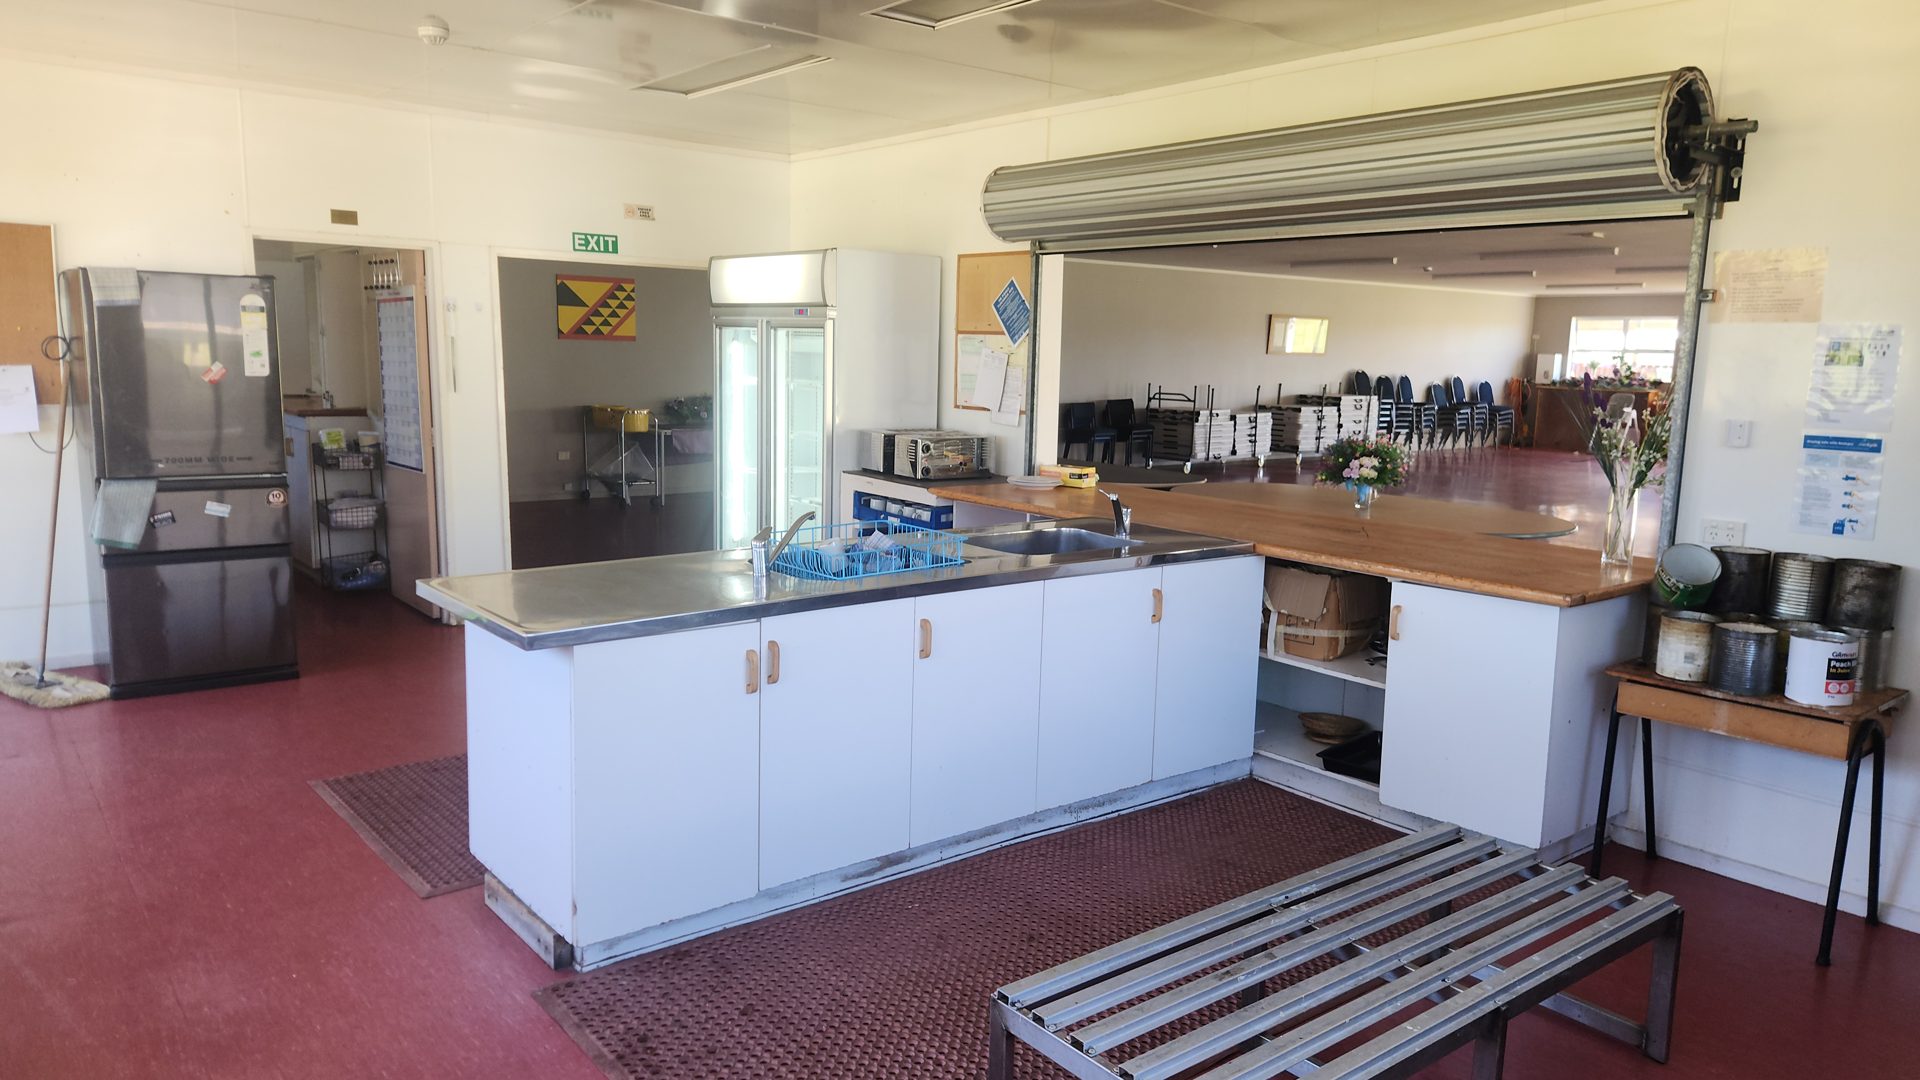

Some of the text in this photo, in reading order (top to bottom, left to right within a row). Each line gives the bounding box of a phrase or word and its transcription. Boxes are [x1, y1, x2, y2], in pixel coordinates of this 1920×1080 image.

[574, 234, 616, 252] EXIT
[164, 455, 236, 464] 700MM WIDE
